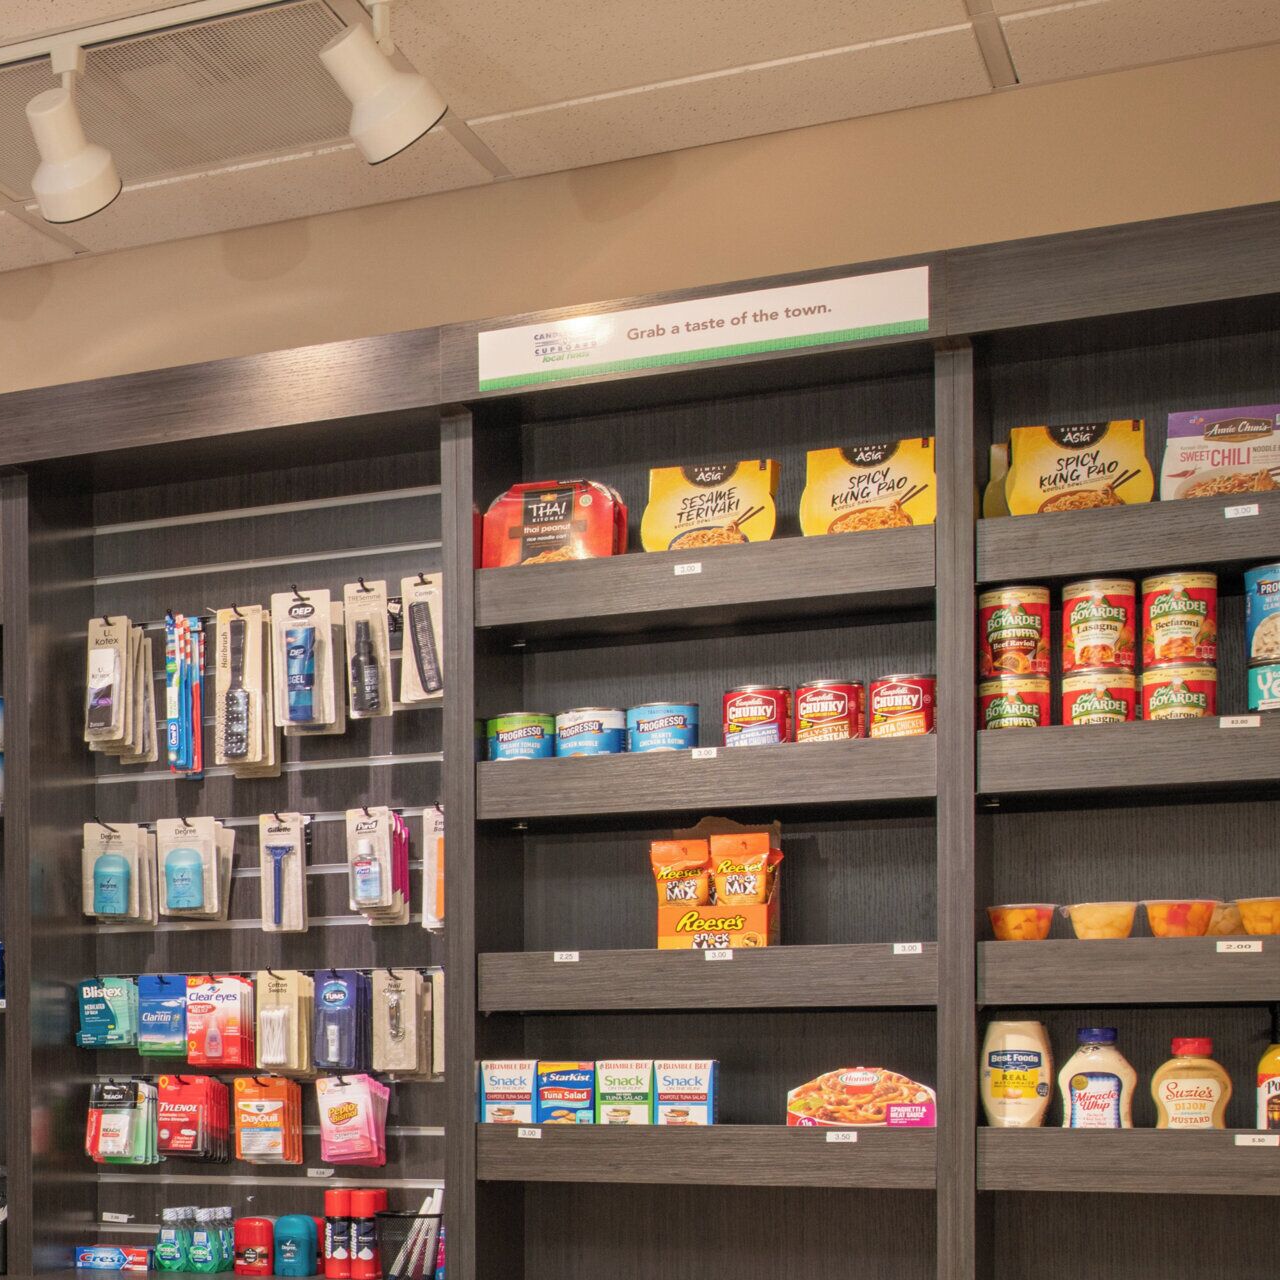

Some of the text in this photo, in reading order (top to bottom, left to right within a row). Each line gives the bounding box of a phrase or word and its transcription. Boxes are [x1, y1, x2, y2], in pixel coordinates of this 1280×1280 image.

[627, 303, 831, 341] Grab a taste of the town.
[1063, 432, 1091, 443] Asia
[855, 451, 883, 462] Asia
[1056, 451, 1099, 472] SPICY
[1180, 447, 1250, 467] SWEET CHILI
[696, 472, 722, 482] Asia
[848, 468, 890, 491] SPICY
[1039, 460, 1118, 489] KUNG PAO
[831, 476, 907, 508] KUNG PAO
[682, 488, 736, 510] SESAME
[528, 502, 566, 516] THAI
[677, 501, 740, 523] TERIYAKI
[524, 524, 570, 534] thai peanut
[292, 607, 312, 615] DEP
[1070, 607, 1126, 622] BOYARDEE
[1150, 600, 1206, 617] BOYARDEE
[987, 615, 1041, 630] BOYARDEE
[1077, 622, 1118, 633] Lasagna
[1155, 619, 1199, 630] Beefaroni
[95, 636, 119, 645] Kotex
[221, 632, 229, 669] Hairbrush
[873, 695, 919, 709] CHUNKY
[1149, 693, 1206, 709] BOYARDEE
[729, 705, 773, 719] CHUNKY
[800, 701, 844, 715] CHUNKY
[986, 703, 1039, 719] BOYARDEE
[1071, 701, 1128, 715] BOYARDEE
[560, 722, 599, 738] PROGRESSO
[640, 718, 683, 732] PROGRESSO
[499, 727, 540, 741] PROGRESSO
[101, 833, 121, 841] Degree
[175, 828, 196, 836] Degree
[717, 860, 762, 874] Reese's
[676, 911, 746, 932] Reese's
[83, 986, 123, 999] Blistex
[189, 992, 237, 1002] Clear eyes
[326, 992, 344, 1001] TUMS
[142, 1012, 171, 1022] Claritin
[992, 1053, 1039, 1063] Best Foods
[490, 1076, 526, 1086] Snack
[548, 1073, 589, 1082] StarKist
[604, 1076, 643, 1086] Snack
[663, 1076, 702, 1086] Snack
[1002, 1073, 1028, 1081] REAL
[1075, 1089, 1118, 1103] Miracle
[1166, 1082, 1214, 1100] Suzie's
[159, 1102, 198, 1112] TYLENOL
[1081, 1100, 1110, 1112] Whip
[1175, 1102, 1206, 1111] DIJON
[241, 1114, 278, 1124] DayQuil
[1171, 1115, 1210, 1124] MUSTARD
[79, 1252, 125, 1264] Crest
